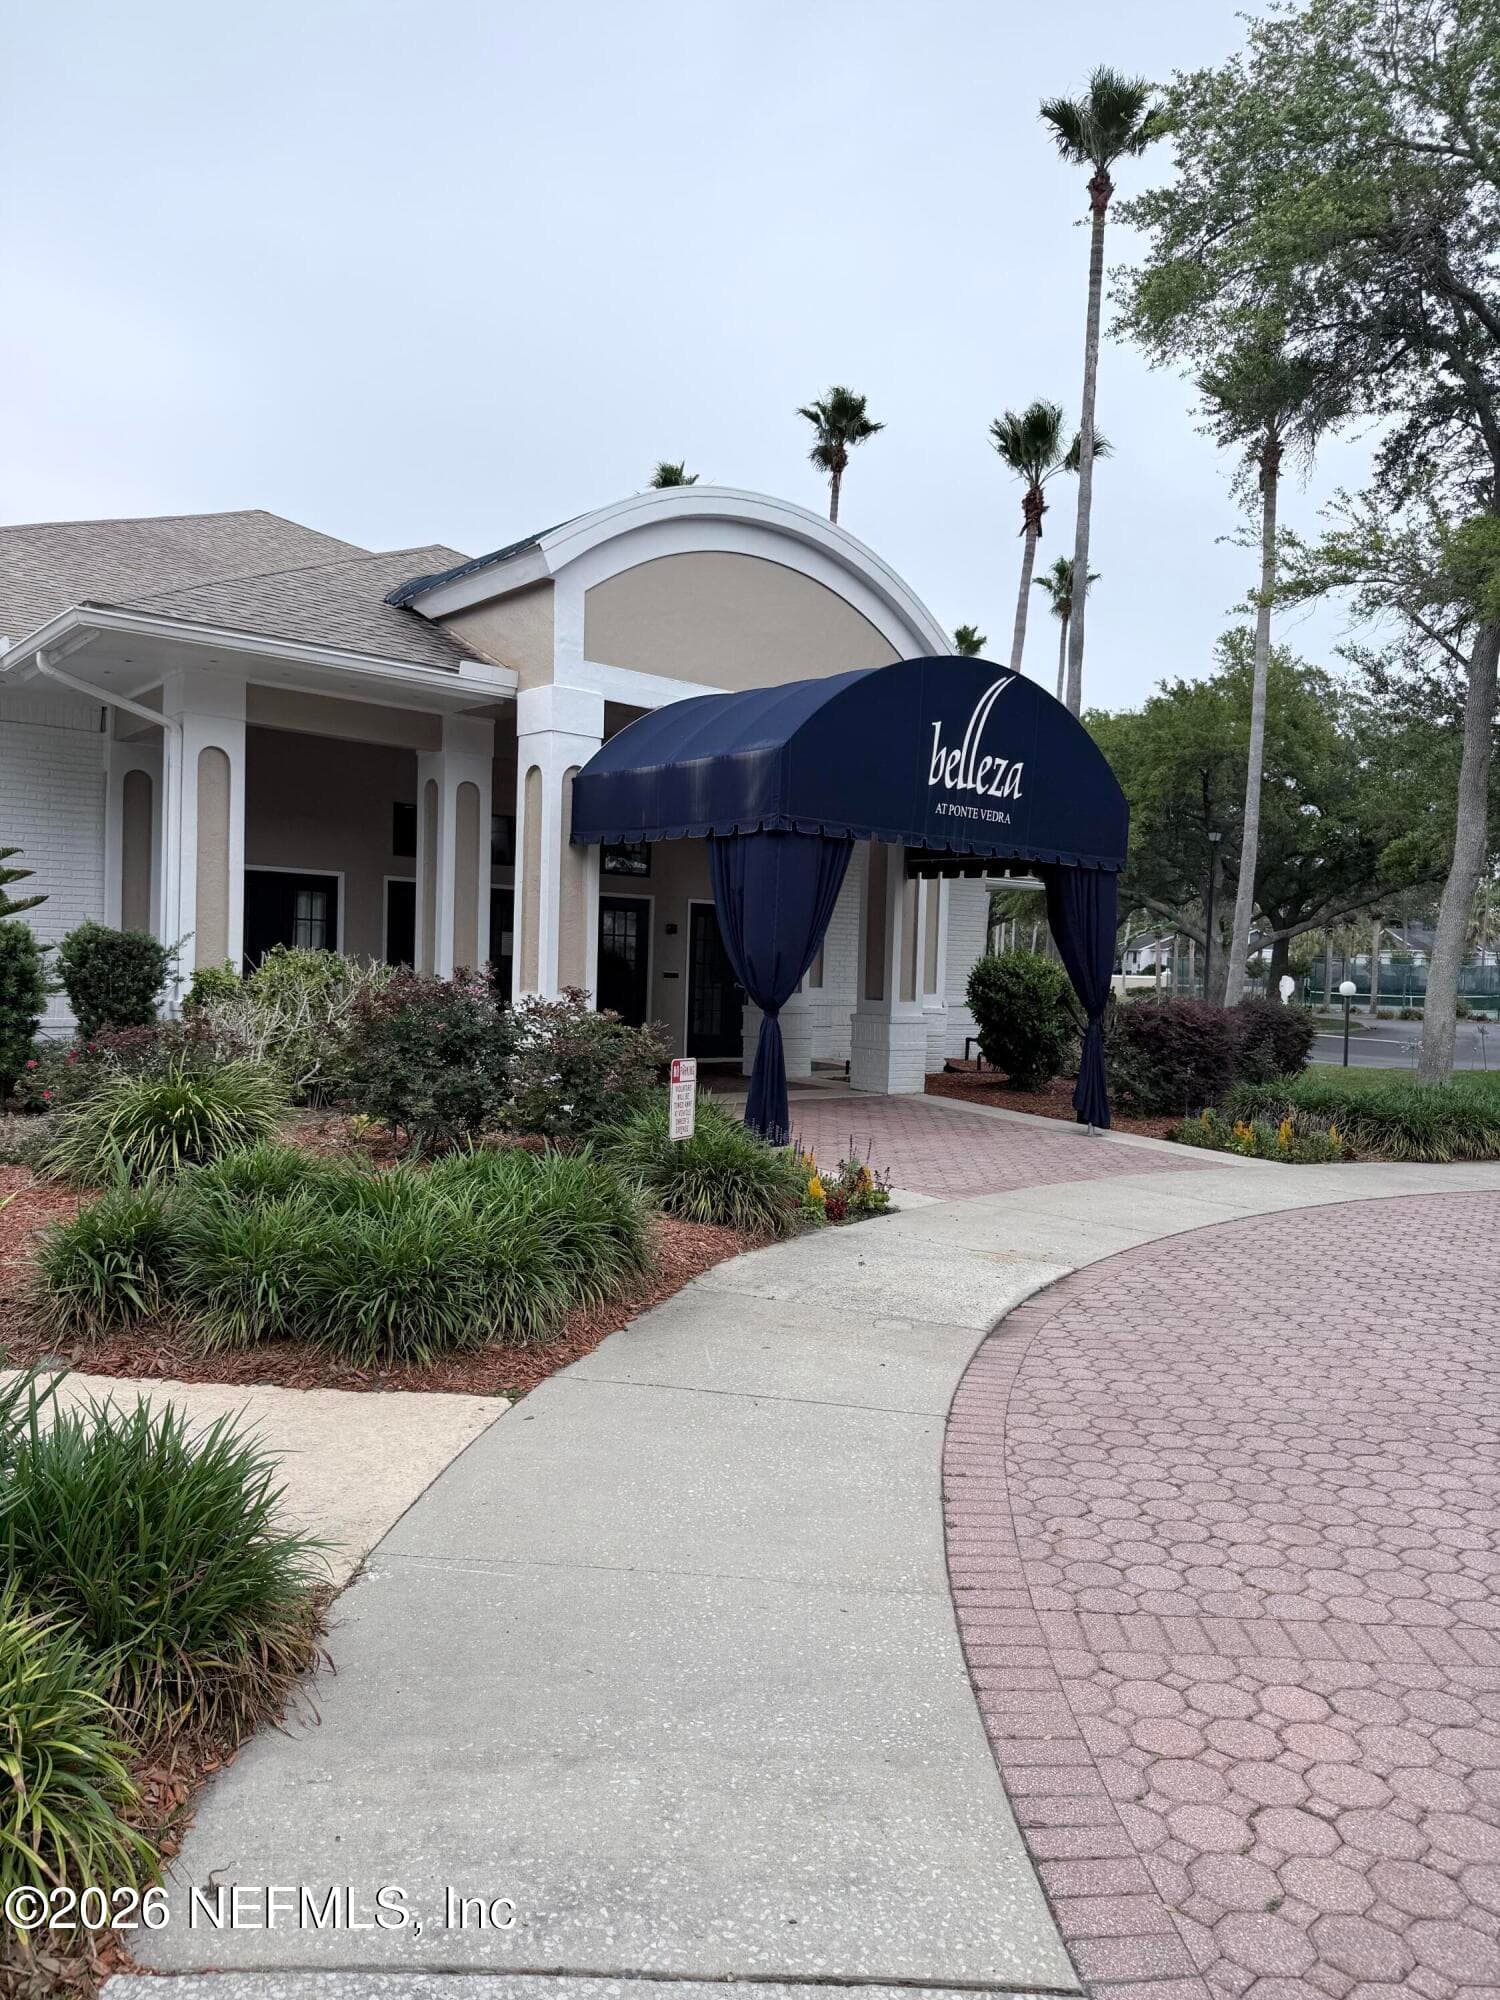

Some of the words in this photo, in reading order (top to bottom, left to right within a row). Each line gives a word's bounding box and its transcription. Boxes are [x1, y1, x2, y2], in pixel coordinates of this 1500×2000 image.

[928, 675, 1024, 800] belleza
[935, 803, 948, 815] AT
[949, 804, 979, 819] PONTE
[980, 809, 1011, 825] VEDRA
